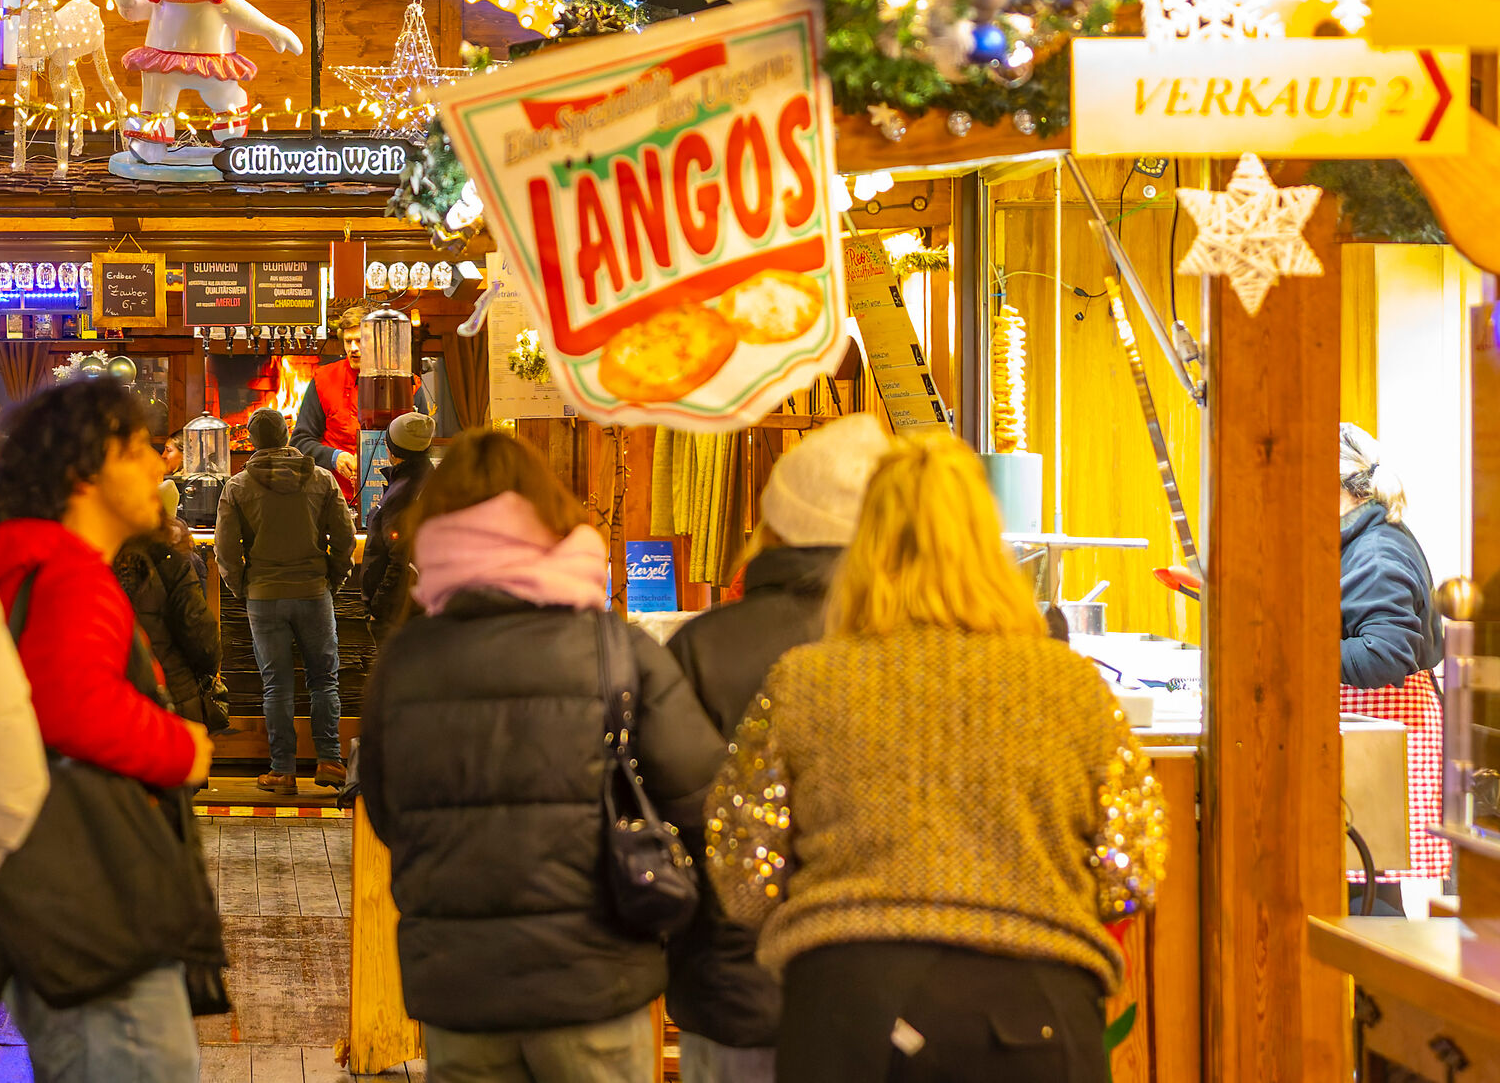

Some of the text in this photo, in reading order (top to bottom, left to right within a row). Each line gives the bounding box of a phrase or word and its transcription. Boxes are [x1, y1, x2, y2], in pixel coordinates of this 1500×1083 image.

[1134, 75, 1412, 117] VERKAUF 2
[230, 145, 406, 175] Glühwein Weiß
[106, 271, 137, 280] Erdbeer
[107, 284, 147, 297] Zauber
[215, 298, 241, 308] MERLOT
